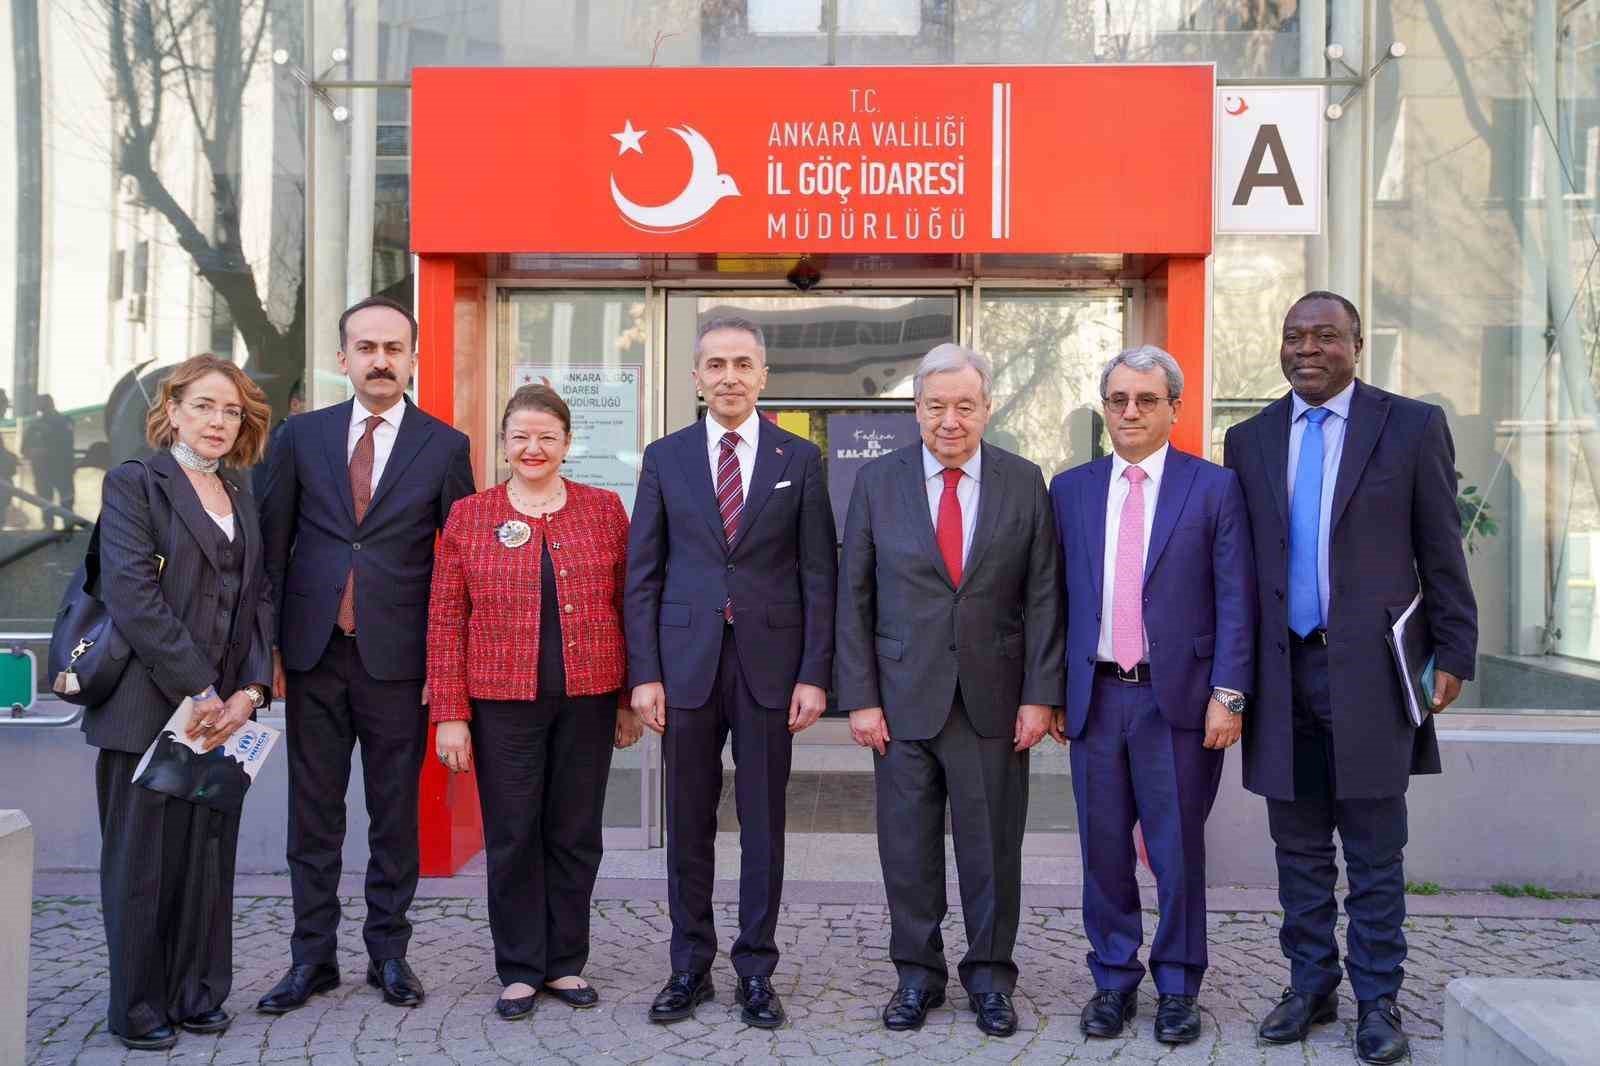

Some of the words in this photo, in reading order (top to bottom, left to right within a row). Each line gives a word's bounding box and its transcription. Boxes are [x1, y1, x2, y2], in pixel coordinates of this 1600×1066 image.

[849, 88, 880, 113] T.C.
[768, 121, 861, 147] ANKARA
[871, 116, 965, 147] VALİLİĞİ
[767, 155, 791, 195] İL
[799, 155, 853, 205] GÖÇ
[860, 155, 965, 195] İDARESİ
[1232, 124, 1304, 206] A
[767, 207, 965, 240] MÜDÜRLÜĞÜ
